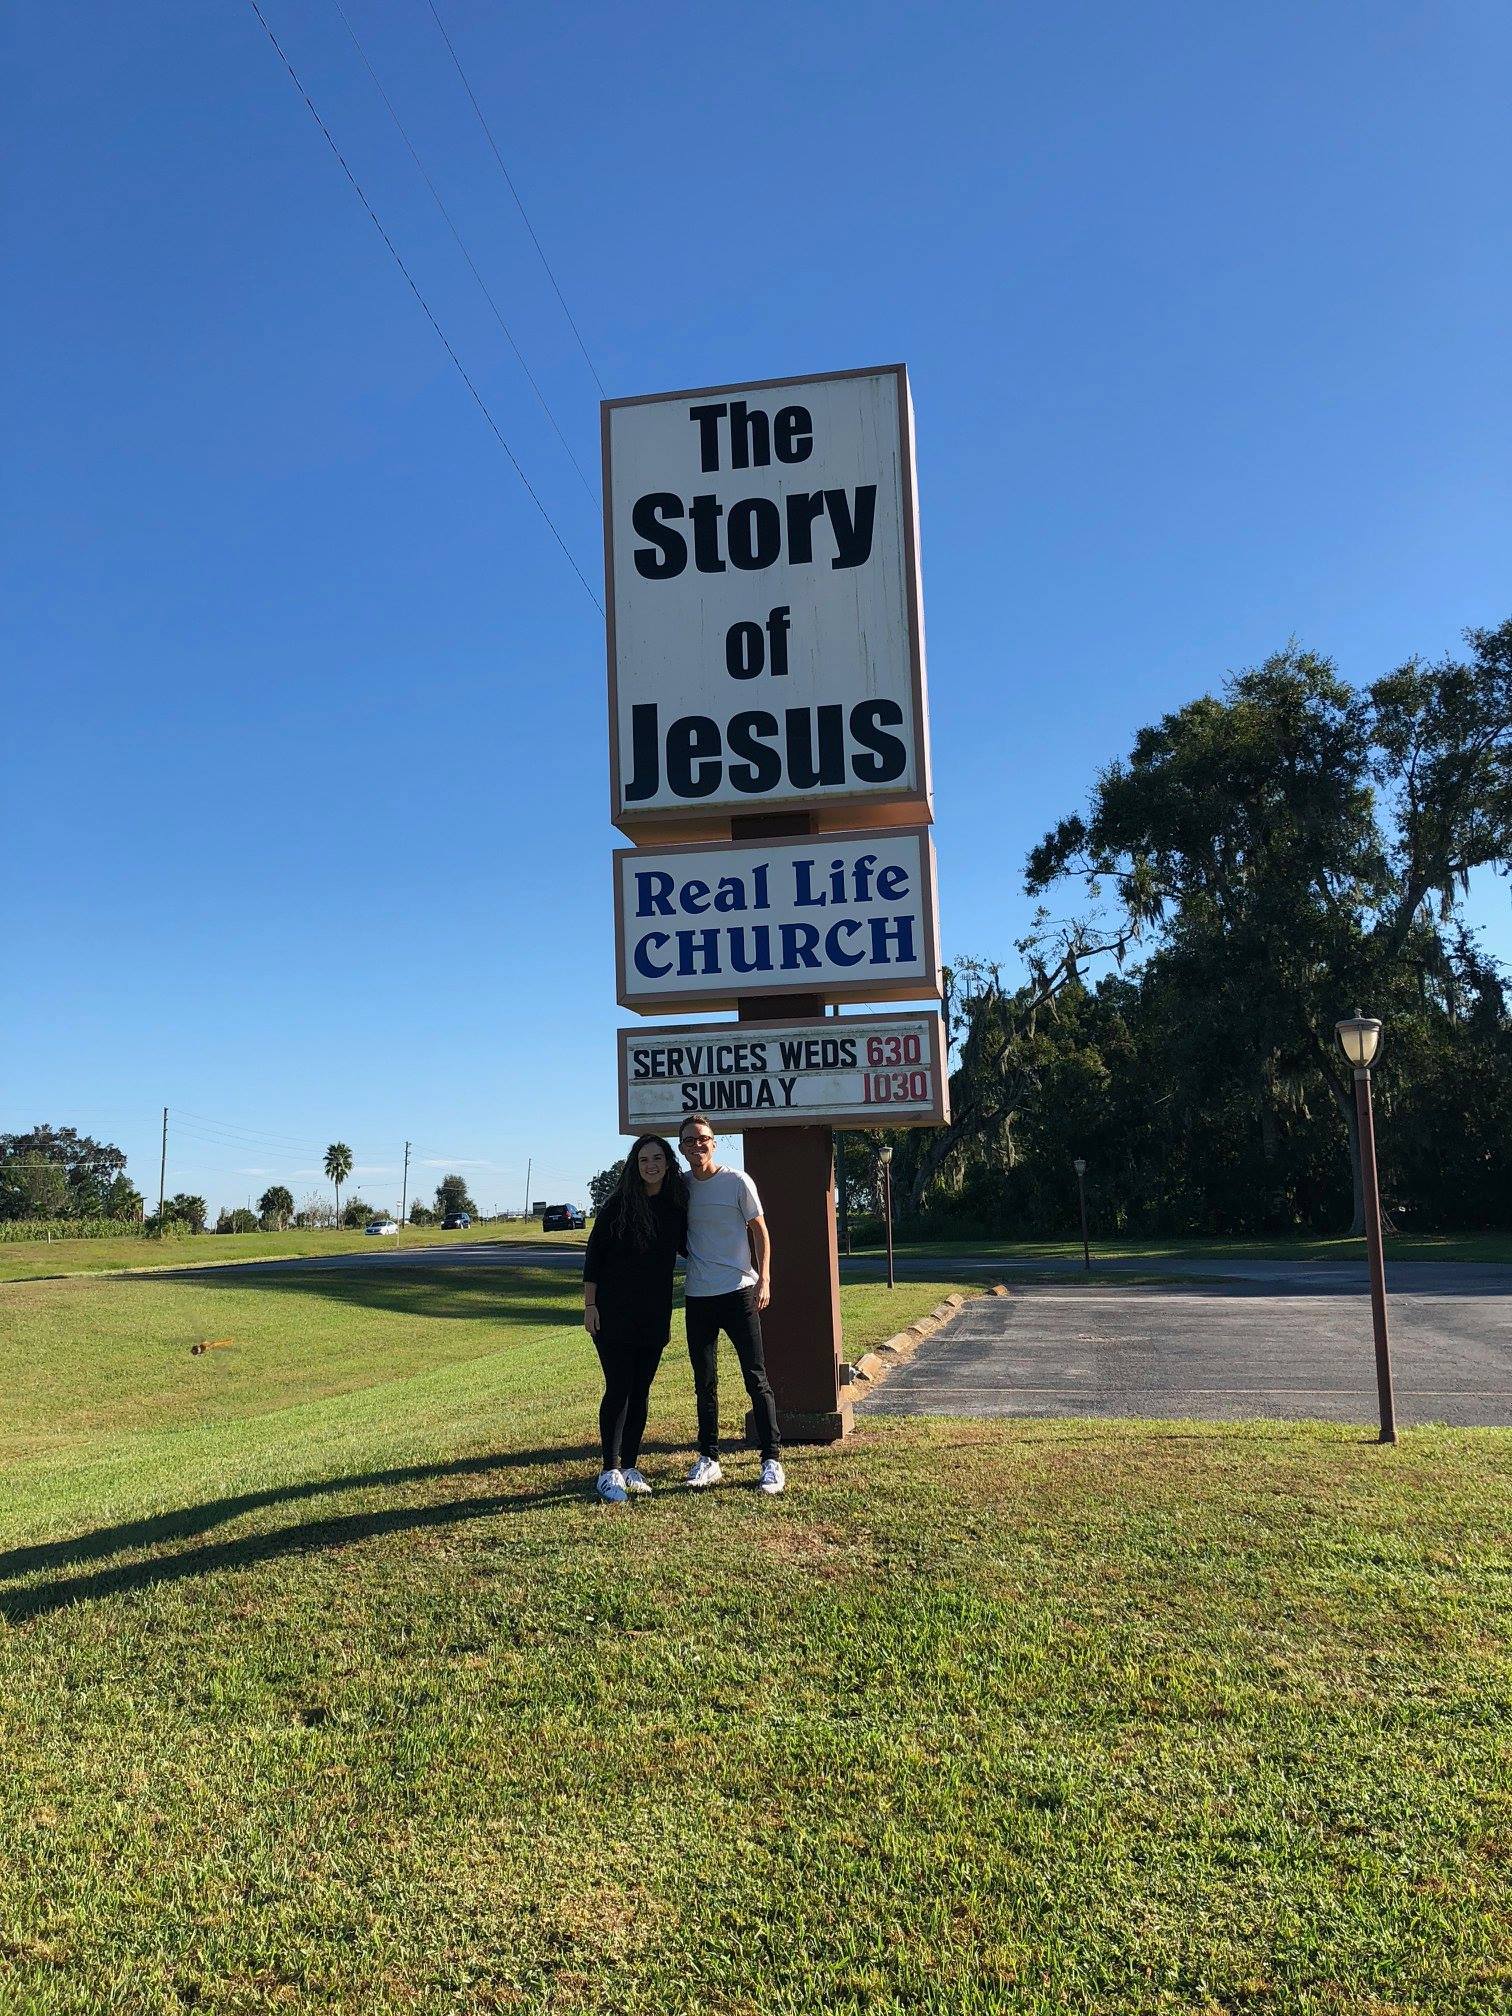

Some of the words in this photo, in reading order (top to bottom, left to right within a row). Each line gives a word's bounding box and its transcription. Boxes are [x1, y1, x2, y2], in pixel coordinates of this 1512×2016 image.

[690, 400, 813, 473] The
[632, 485, 877, 580] Story
[725, 606, 791, 680] of
[625, 699, 907, 802] Jesus
[635, 862, 771, 917] Real
[792, 855, 910, 907] Life
[634, 915, 918, 979] CHURCH
[633, 1043, 767, 1078] SERVICES
[780, 1038, 857, 1071] WEDS
[866, 1034, 921, 1066] 630
[681, 1077, 798, 1111] SUNDAY
[862, 1071, 928, 1104] 1030
